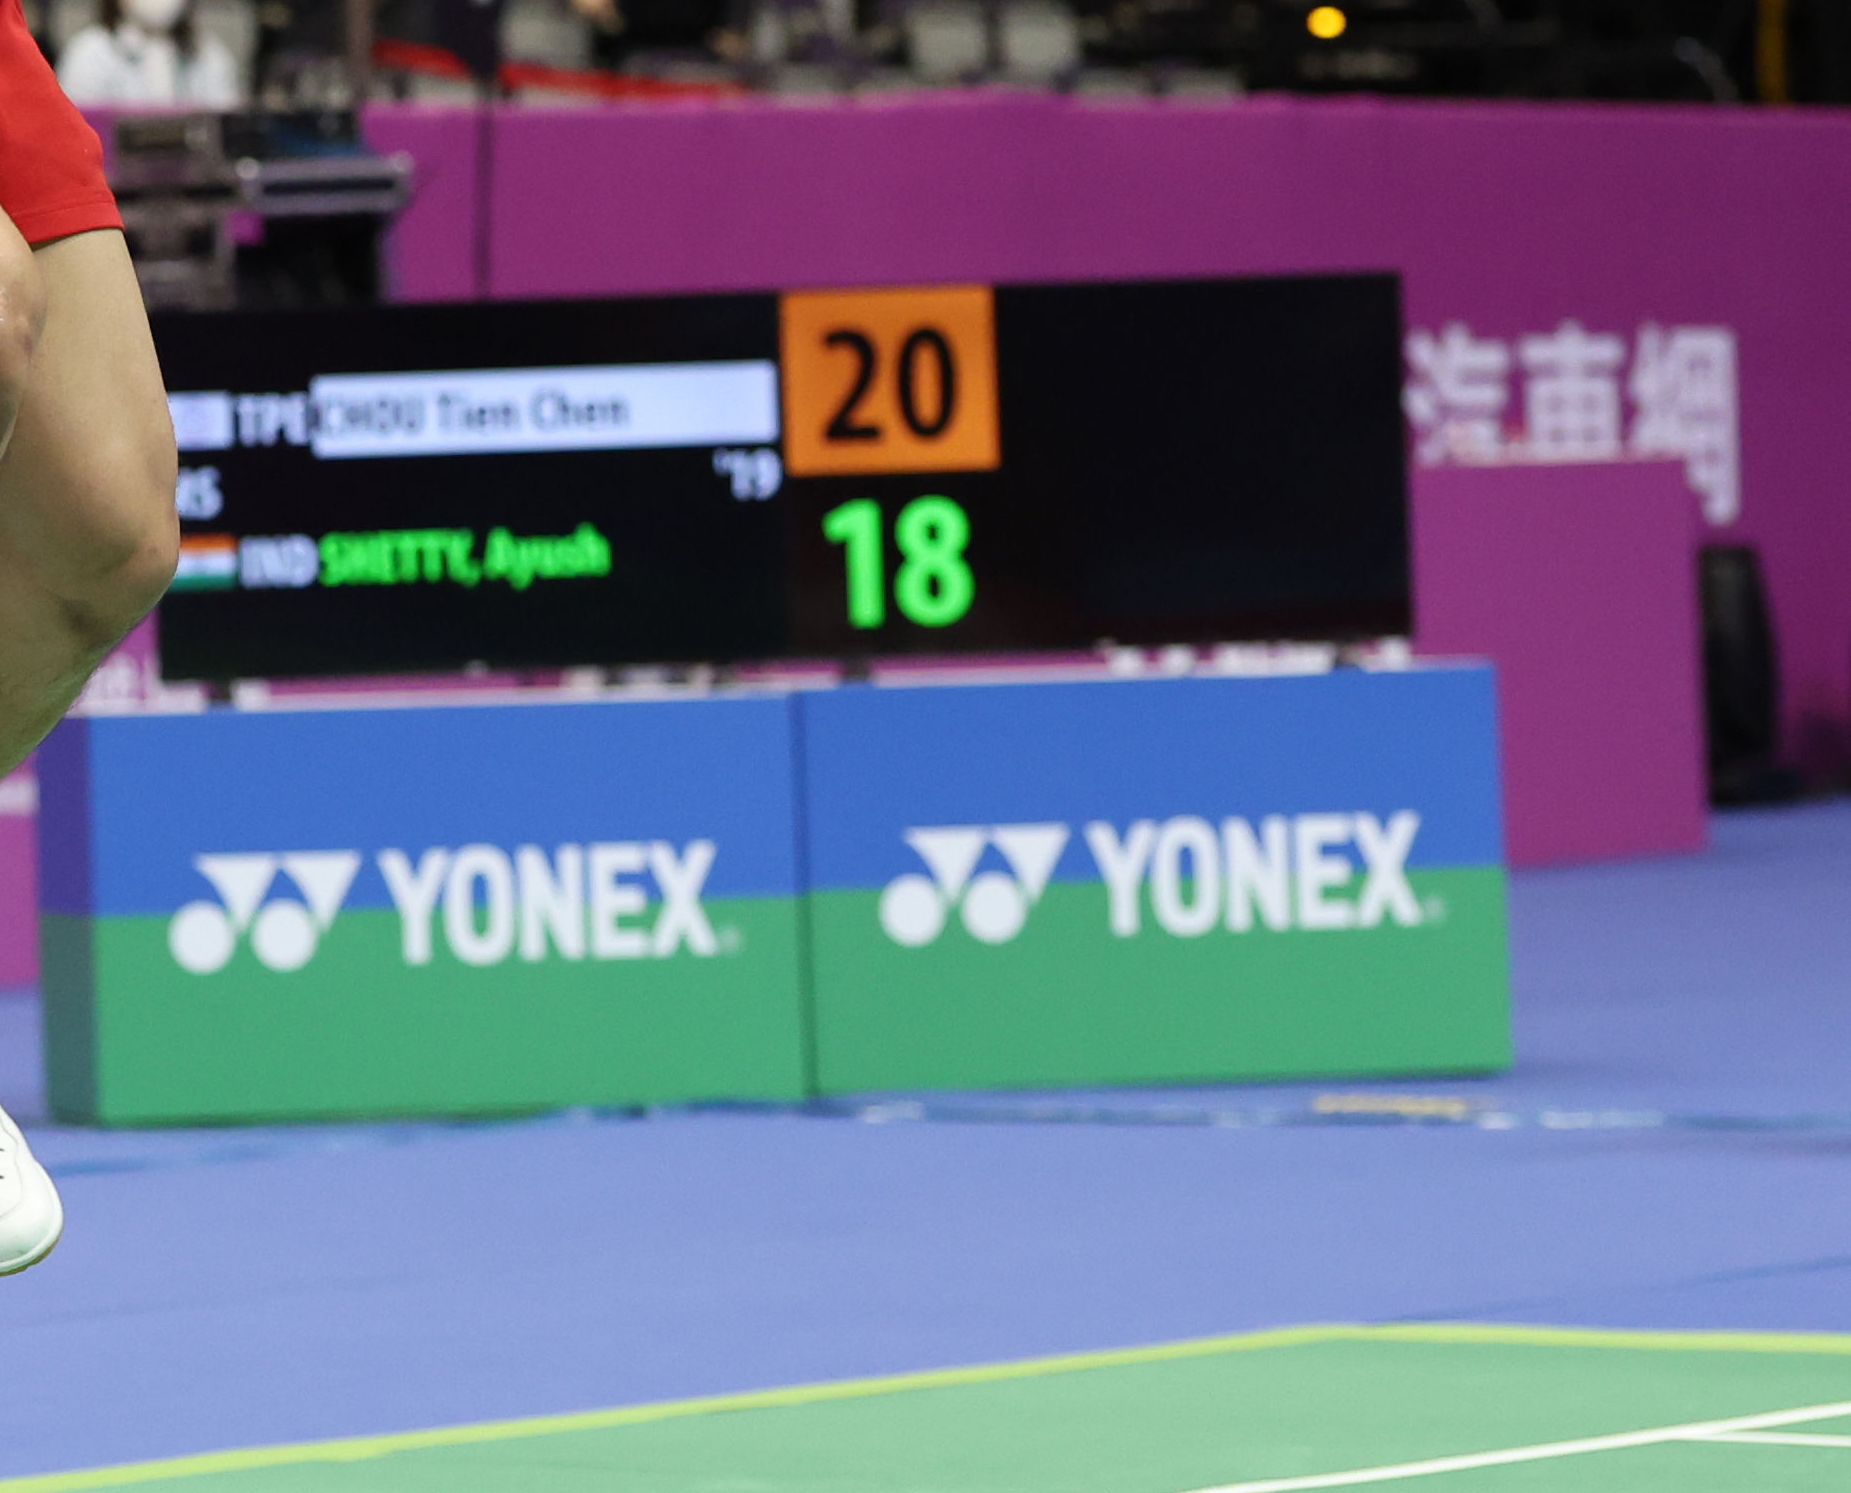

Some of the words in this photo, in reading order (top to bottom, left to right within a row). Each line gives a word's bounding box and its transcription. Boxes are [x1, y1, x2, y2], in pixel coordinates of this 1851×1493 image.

[434, 392, 522, 432] Tien
[529, 387, 633, 430] Chen
[823, 326, 956, 441] 20
[238, 532, 318, 589] IND
[484, 522, 612, 590] Ayush
[822, 495, 975, 629] 18
[377, 839, 718, 966] YONEX
[1082, 810, 1423, 938] YONEX
